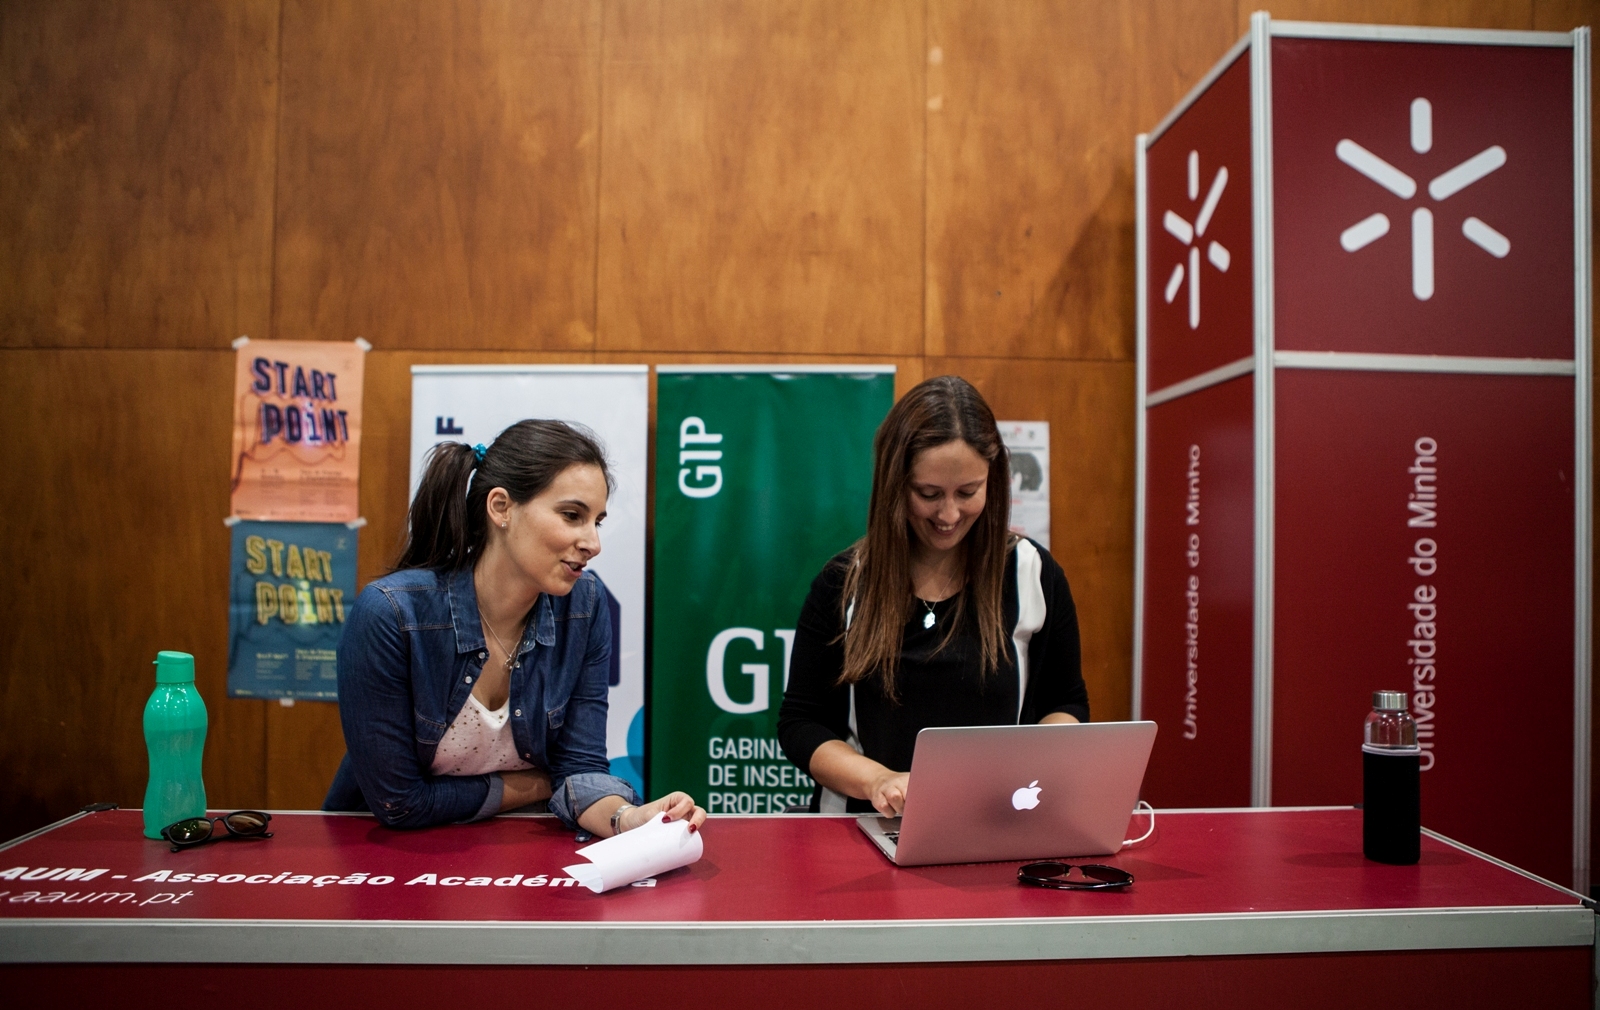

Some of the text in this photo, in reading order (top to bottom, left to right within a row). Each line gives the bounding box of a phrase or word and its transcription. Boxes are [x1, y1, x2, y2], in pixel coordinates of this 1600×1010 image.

[252, 357, 337, 401] START
[435, 416, 464, 435] F
[678, 416, 723, 498] GIP
[245, 535, 333, 582] START
[1184, 444, 1201, 740] Universidade do Minho
[1407, 436, 1438, 771] Universidade do Minho
[708, 764, 816, 788] DE INSER
[0, 890, 194, 907] aaum.pt
[132, 869, 395, 888] Associação
[404, 873, 657, 888] Académa
